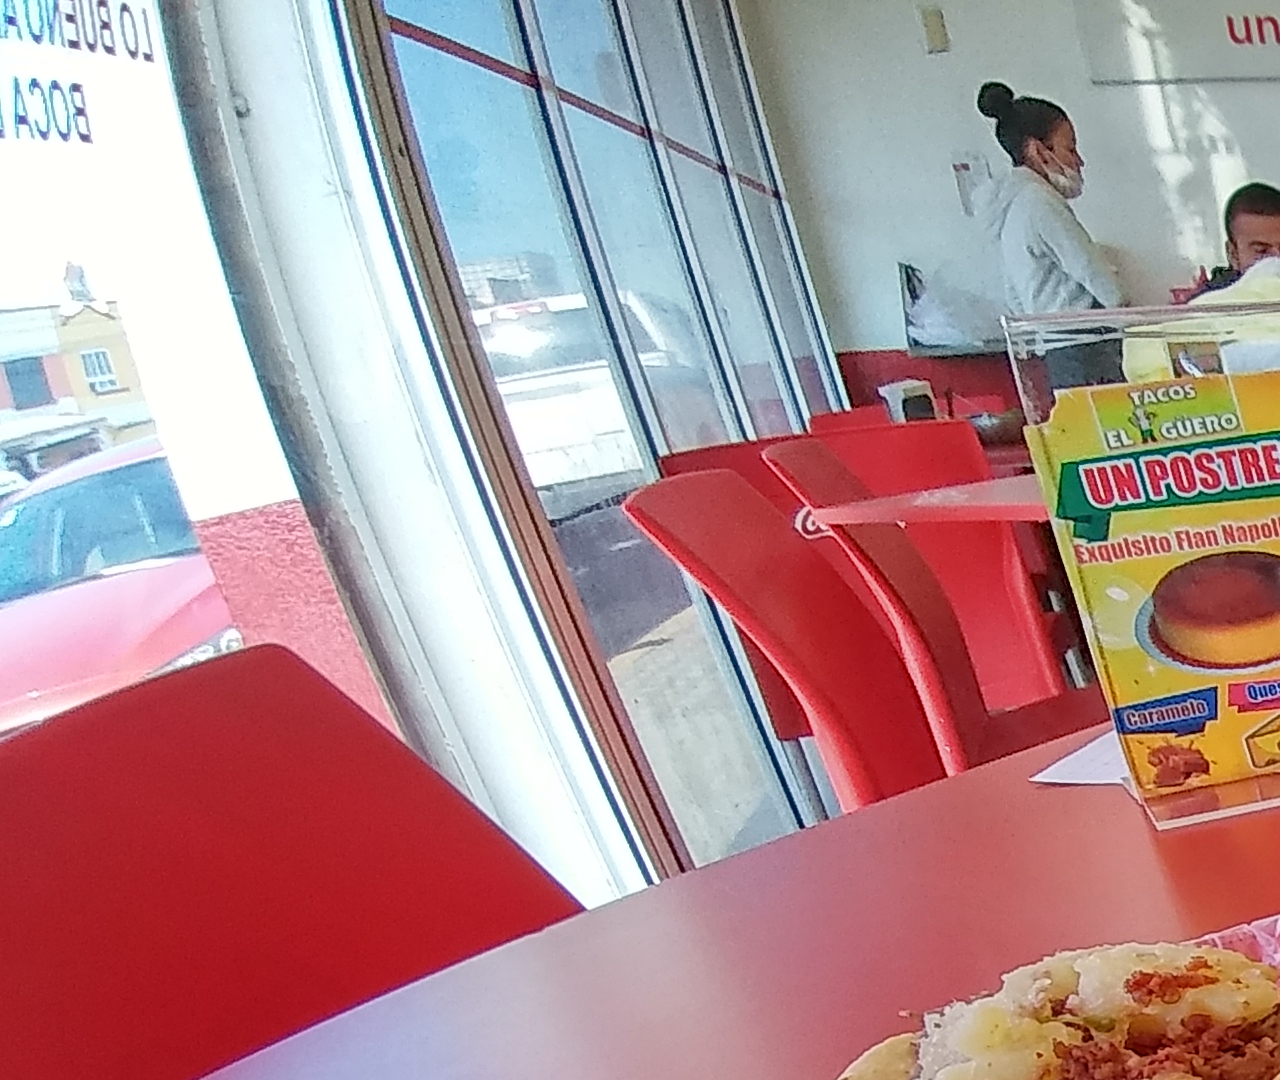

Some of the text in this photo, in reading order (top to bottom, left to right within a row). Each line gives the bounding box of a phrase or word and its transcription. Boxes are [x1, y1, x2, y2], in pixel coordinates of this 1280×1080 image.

[1129, 382, 1197, 406] TACOS
[1104, 412, 1239, 449] EL GÜERO
[1081, 460, 1143, 507] UN
[1074, 531, 1173, 565] Exquisito
[1175, 525, 1221, 551] Flan
[1125, 699, 1207, 728] Caramelo
